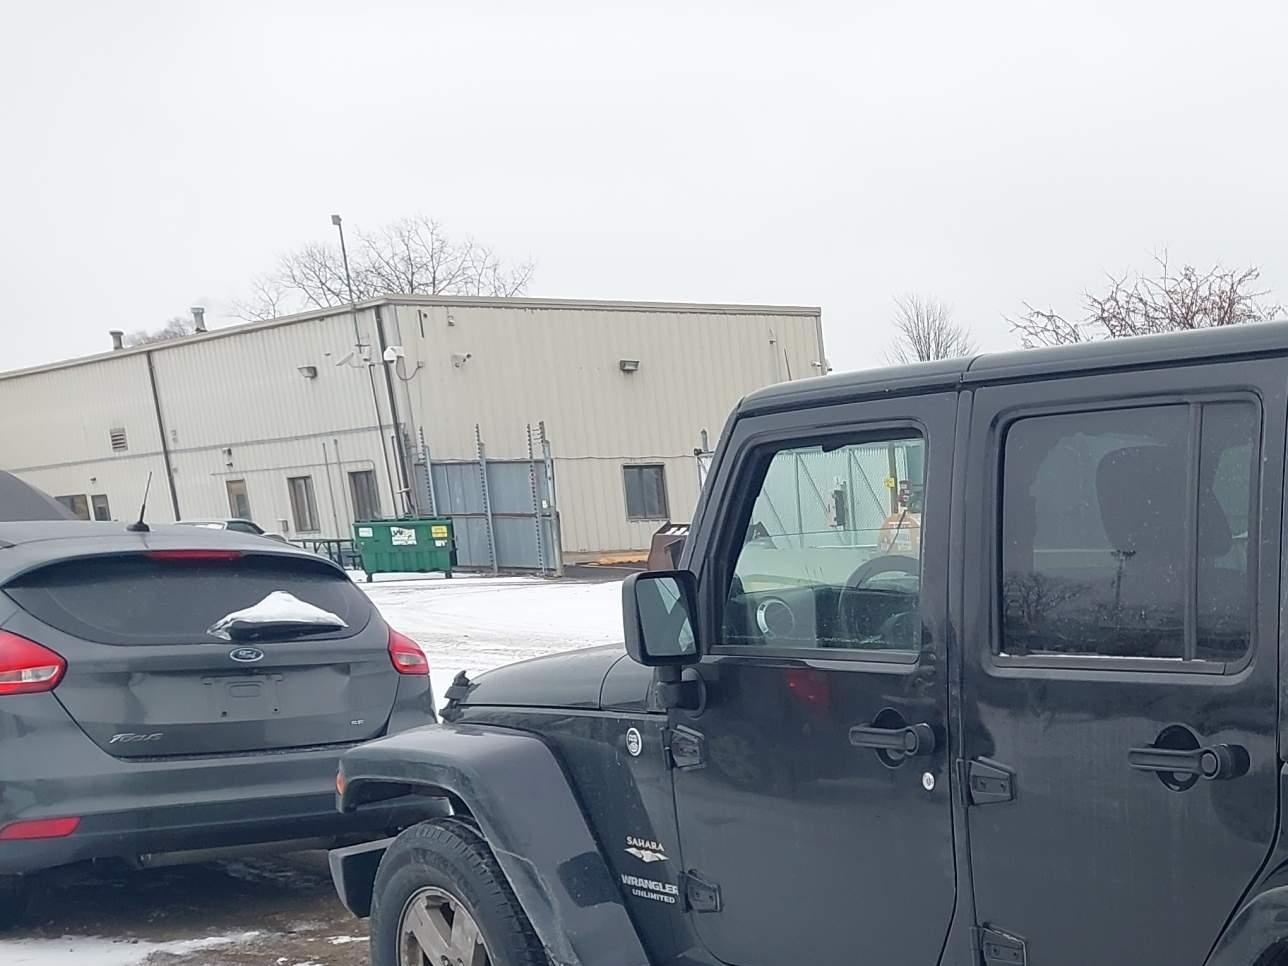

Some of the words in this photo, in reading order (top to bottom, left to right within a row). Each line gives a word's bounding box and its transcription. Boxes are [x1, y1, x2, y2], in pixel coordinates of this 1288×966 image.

[626, 836, 665, 852] SAHARA
[621, 873, 679, 896] WRANGLER
[632, 888, 676, 904] UNLIMITED
